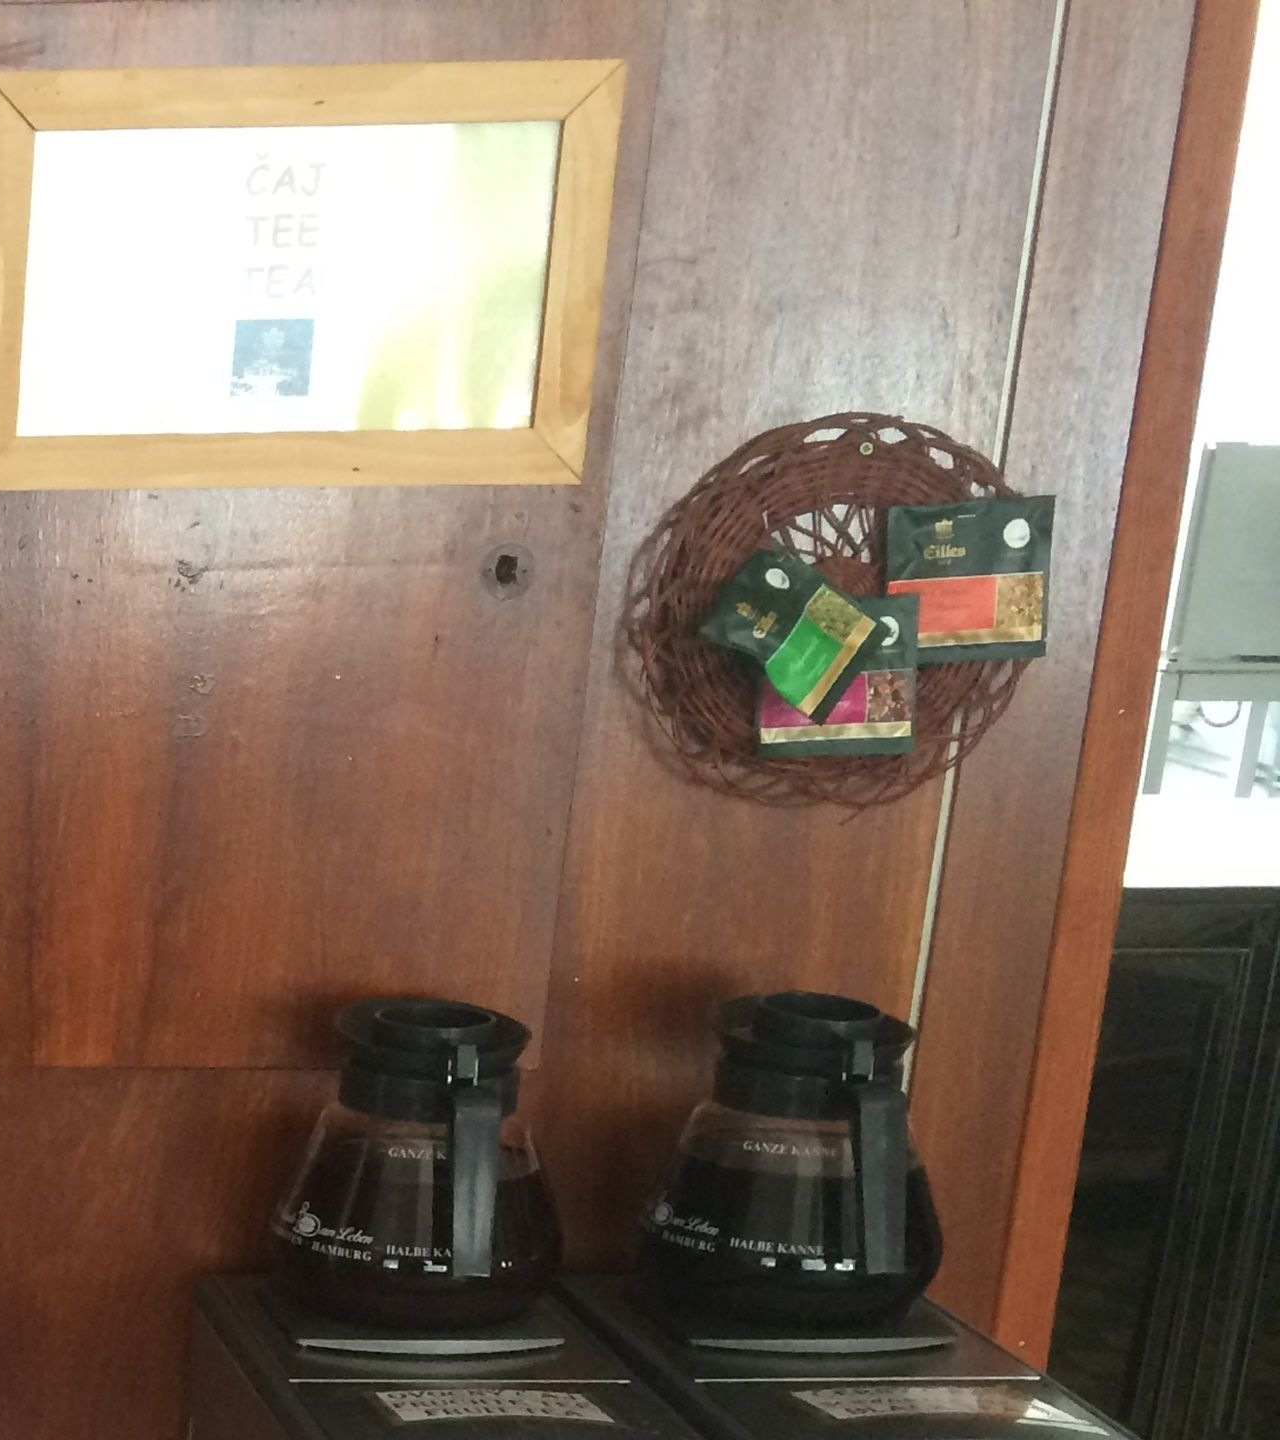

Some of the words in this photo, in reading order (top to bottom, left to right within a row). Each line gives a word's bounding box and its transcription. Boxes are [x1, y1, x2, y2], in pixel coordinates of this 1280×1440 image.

[246, 152, 327, 197] ČAJ
[245, 213, 320, 248] TEE
[241, 264, 316, 299] TEA
[743, 1140, 787, 1154] GANZE
[311, 1241, 372, 1262] HAMBURG
[386, 1244, 430, 1258] HALBE
[730, 1237, 775, 1253] HALBE
